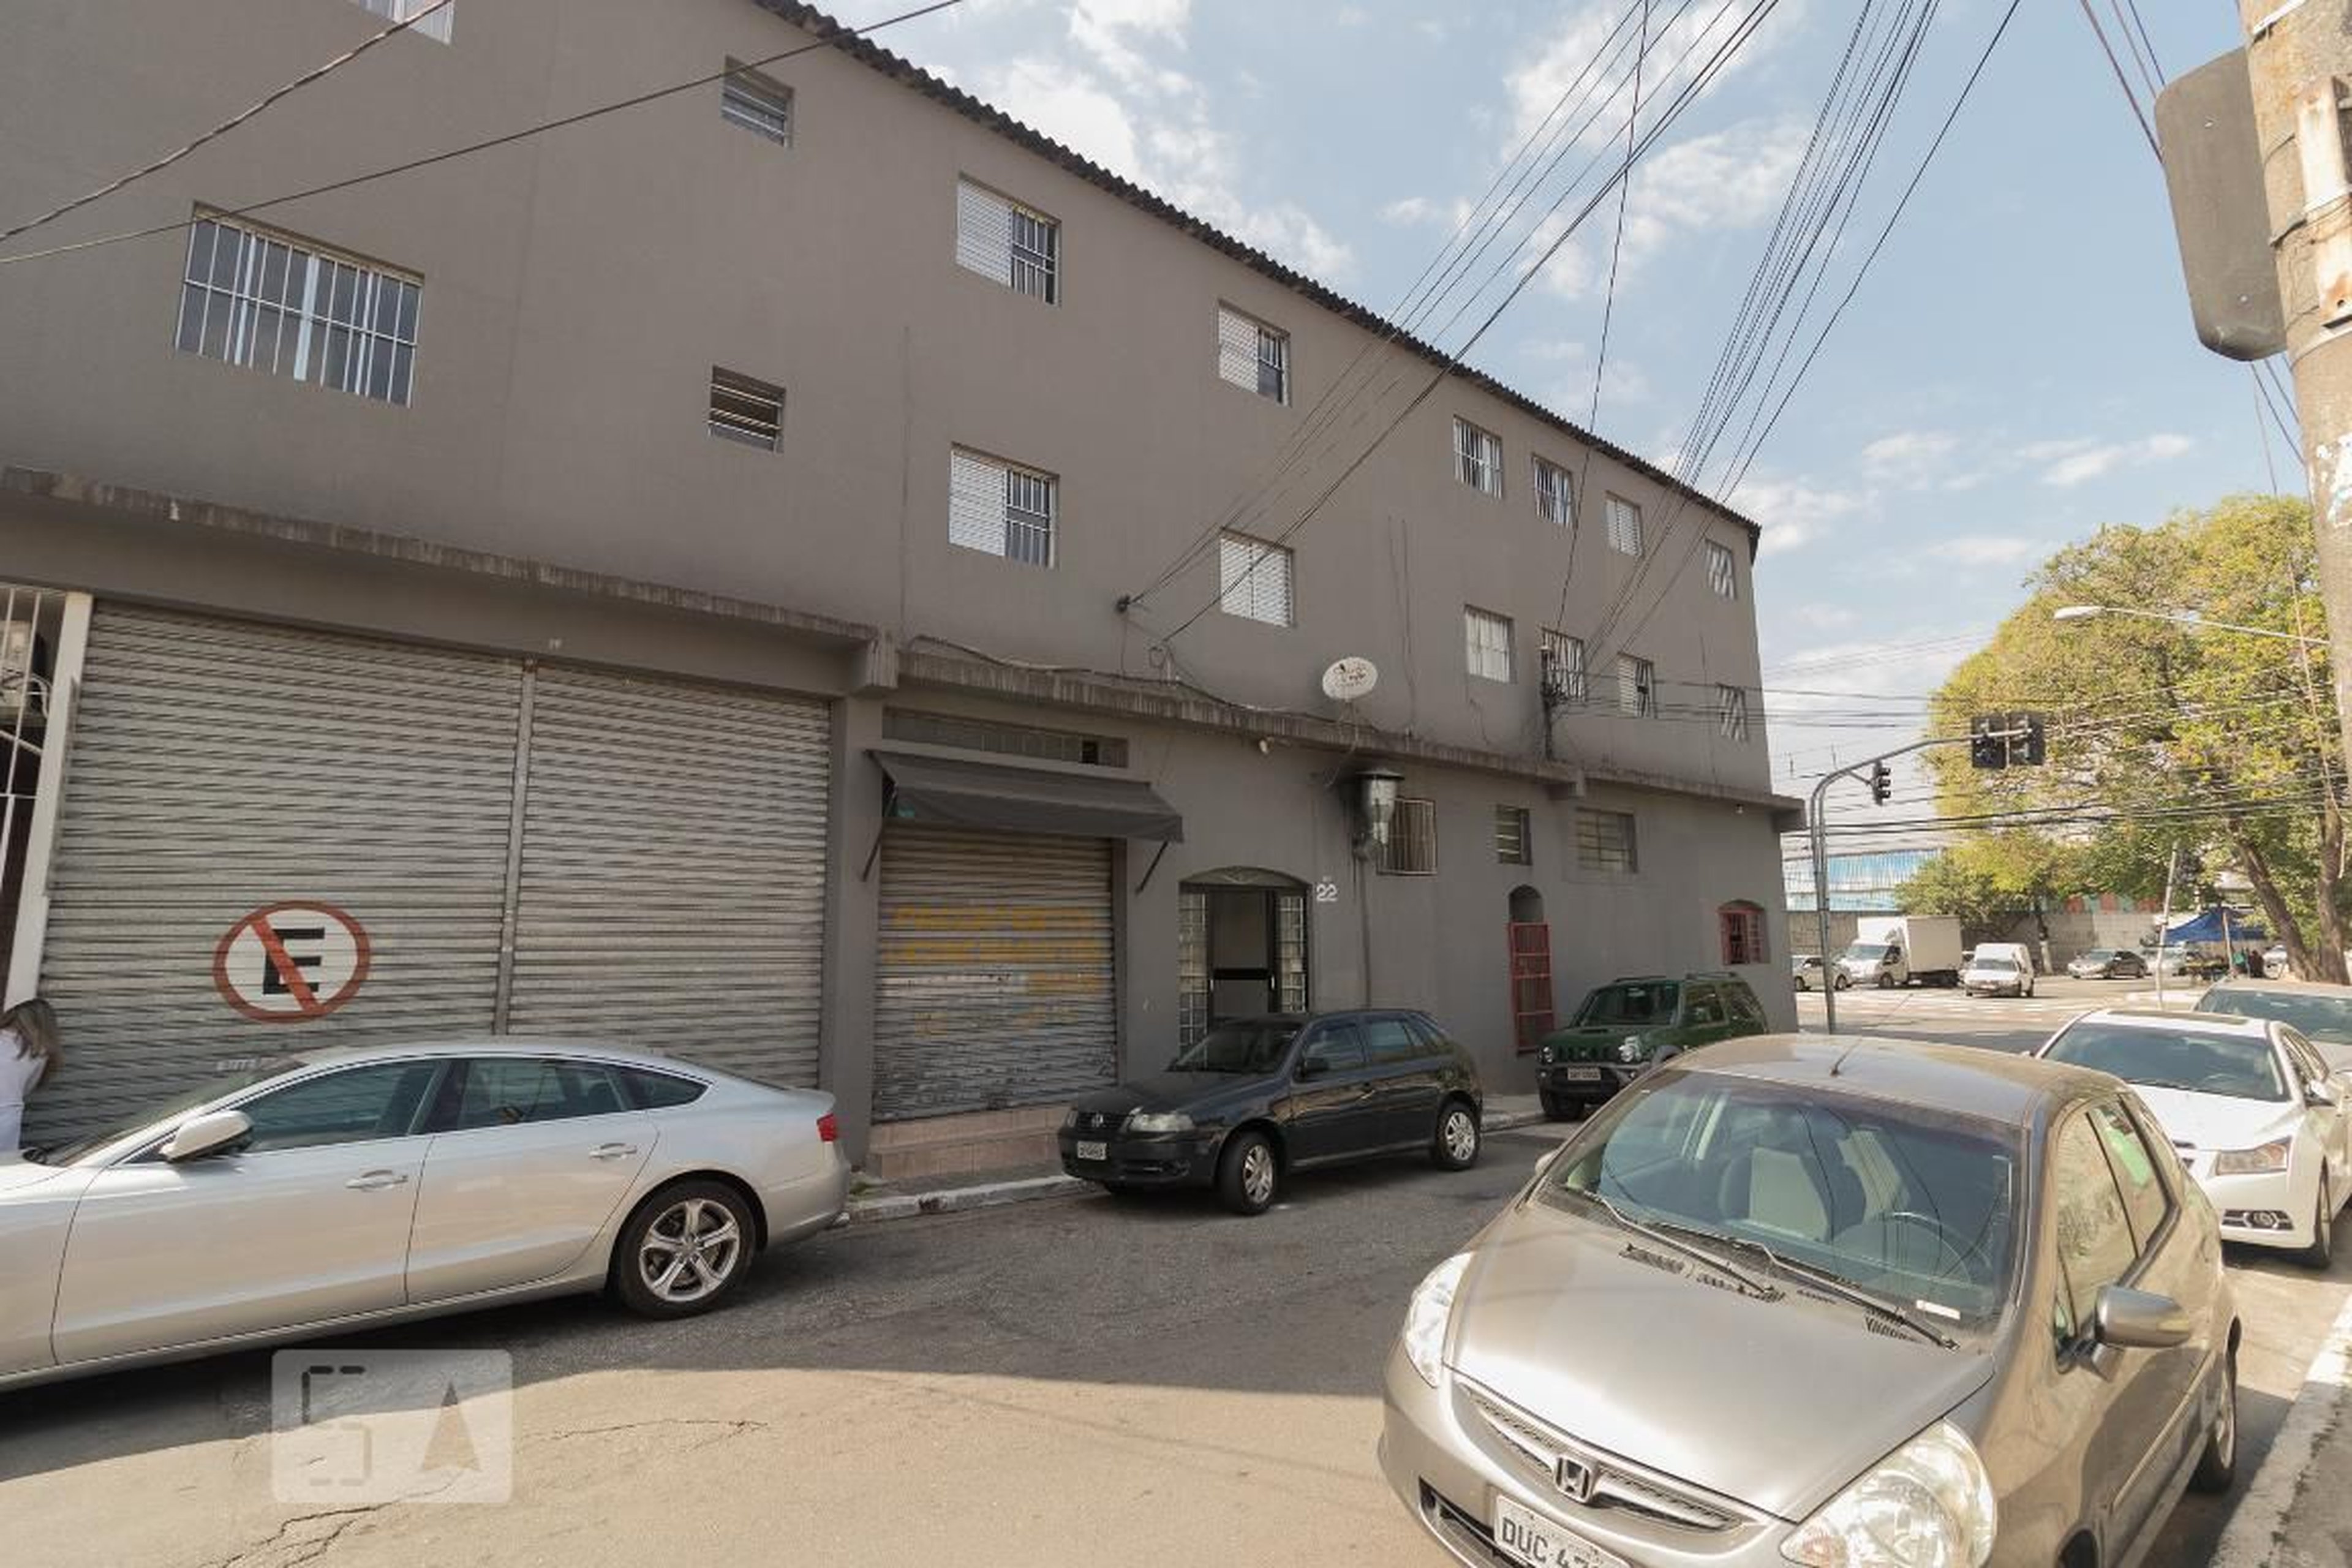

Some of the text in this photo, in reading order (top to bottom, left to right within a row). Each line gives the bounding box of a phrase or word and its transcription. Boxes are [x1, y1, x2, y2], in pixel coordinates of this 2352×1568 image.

[1316, 883, 1337, 902] 22
[263, 927, 325, 995] E
[1502, 1517, 1548, 1562] DUC
